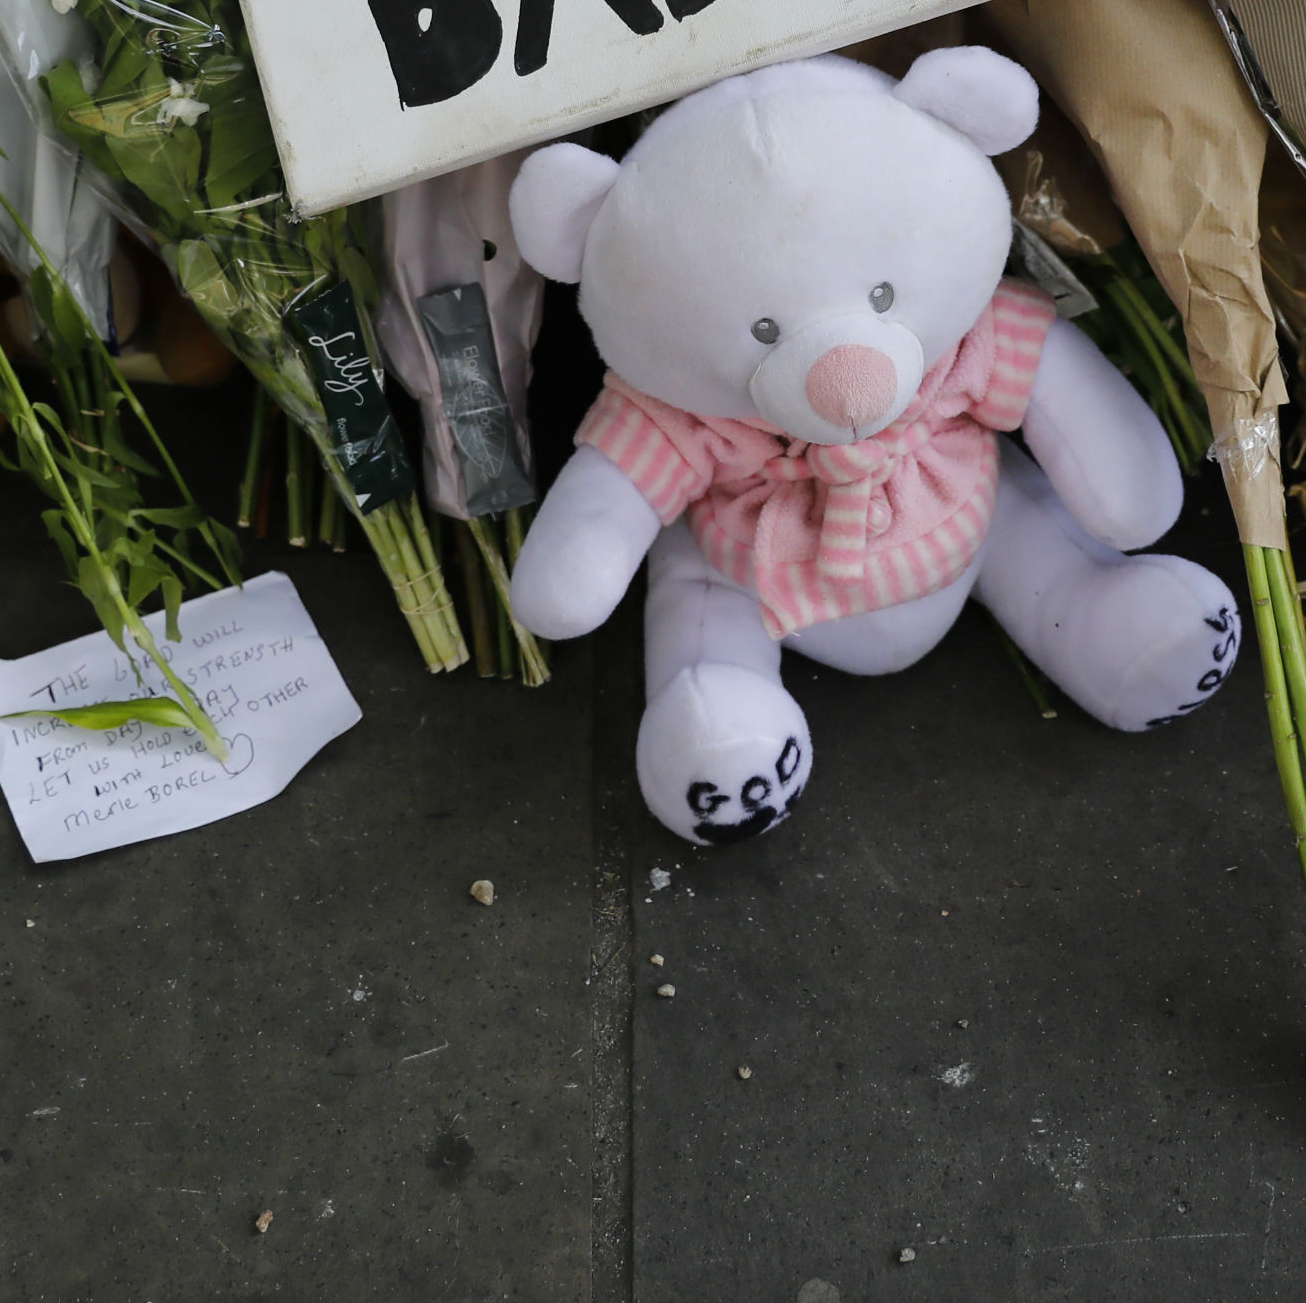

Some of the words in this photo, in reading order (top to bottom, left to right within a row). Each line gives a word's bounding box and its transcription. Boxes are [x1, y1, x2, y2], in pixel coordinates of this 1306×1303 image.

[308, 331, 370, 406] Lily
[29, 663, 98, 704] THE
[192, 619, 246, 649] WILL
[29, 770, 73, 805] LET
[130, 730, 174, 761] HOLD
[246, 676, 310, 713] OTHER
[104, 718, 144, 748] DAY
[199, 683, 241, 711] AY
[149, 770, 218, 805] BOREL
[686, 735, 801, 819] GOD
